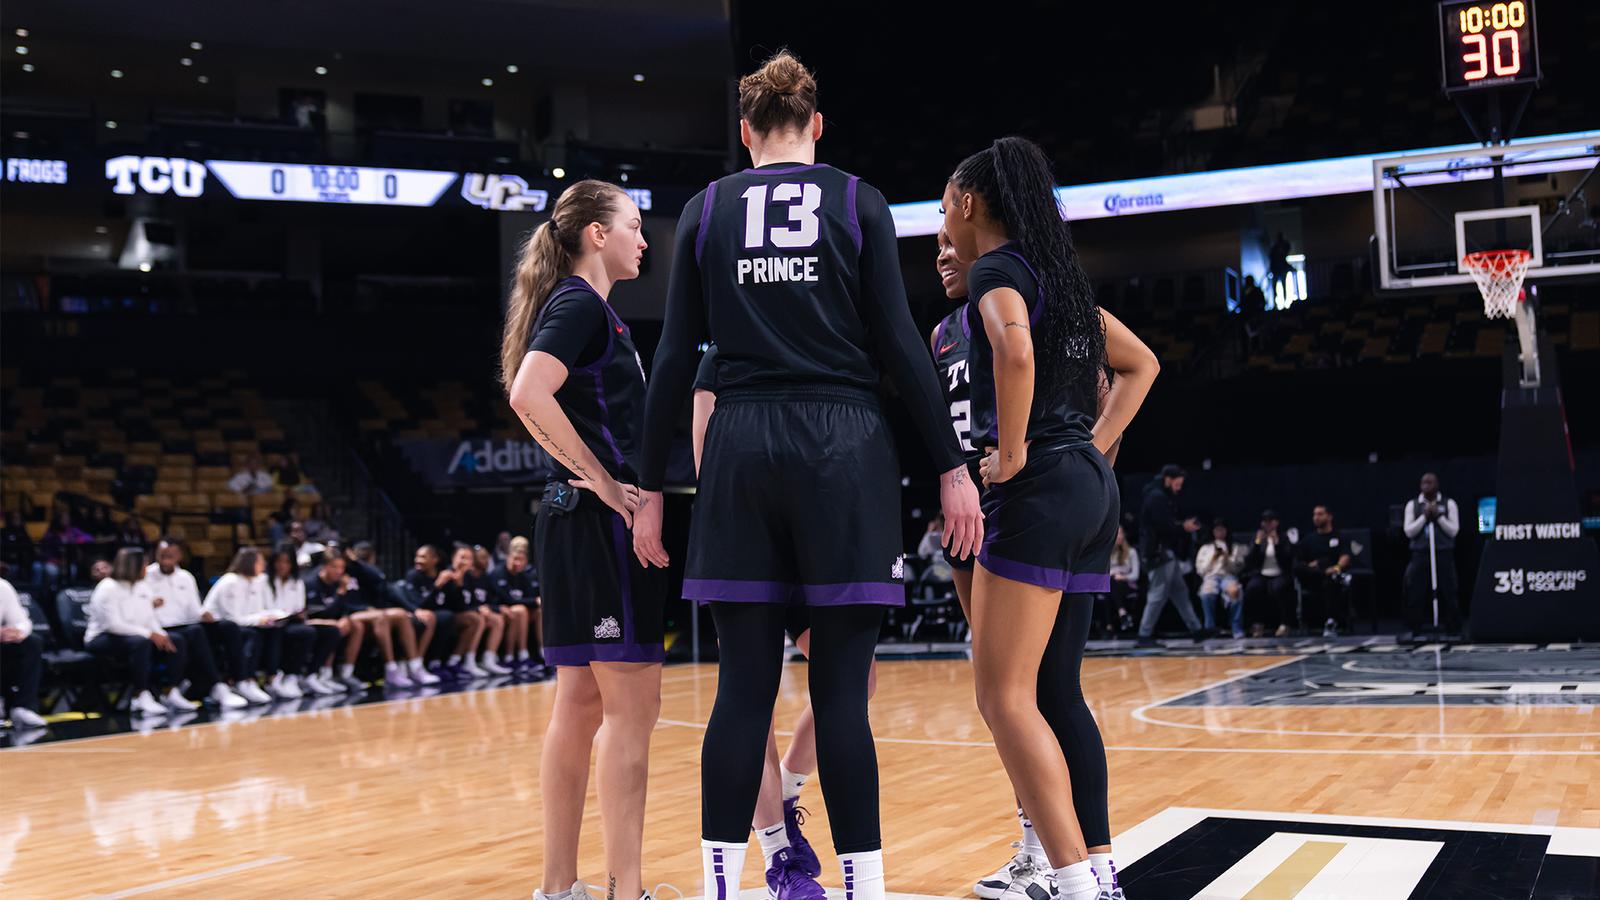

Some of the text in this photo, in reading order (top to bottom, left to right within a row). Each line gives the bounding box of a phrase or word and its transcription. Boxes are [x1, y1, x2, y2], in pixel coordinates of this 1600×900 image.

[1459, 1, 1526, 34] 10:00
[1461, 29, 1521, 81] 30
[6, 157, 68, 185] FROGS
[105, 155, 207, 198] TCU
[271, 168, 285, 195] 0
[308, 164, 360, 191] 10:00
[384, 173, 398, 199] 0
[740, 182, 822, 249] 13
[1103, 193, 1164, 216] Corona
[736, 256, 819, 285] PRINCE
[447, 439, 557, 475] Additi
[1495, 522, 1581, 541] FIRST WATCH
[1526, 569, 1587, 583] ROOFING
